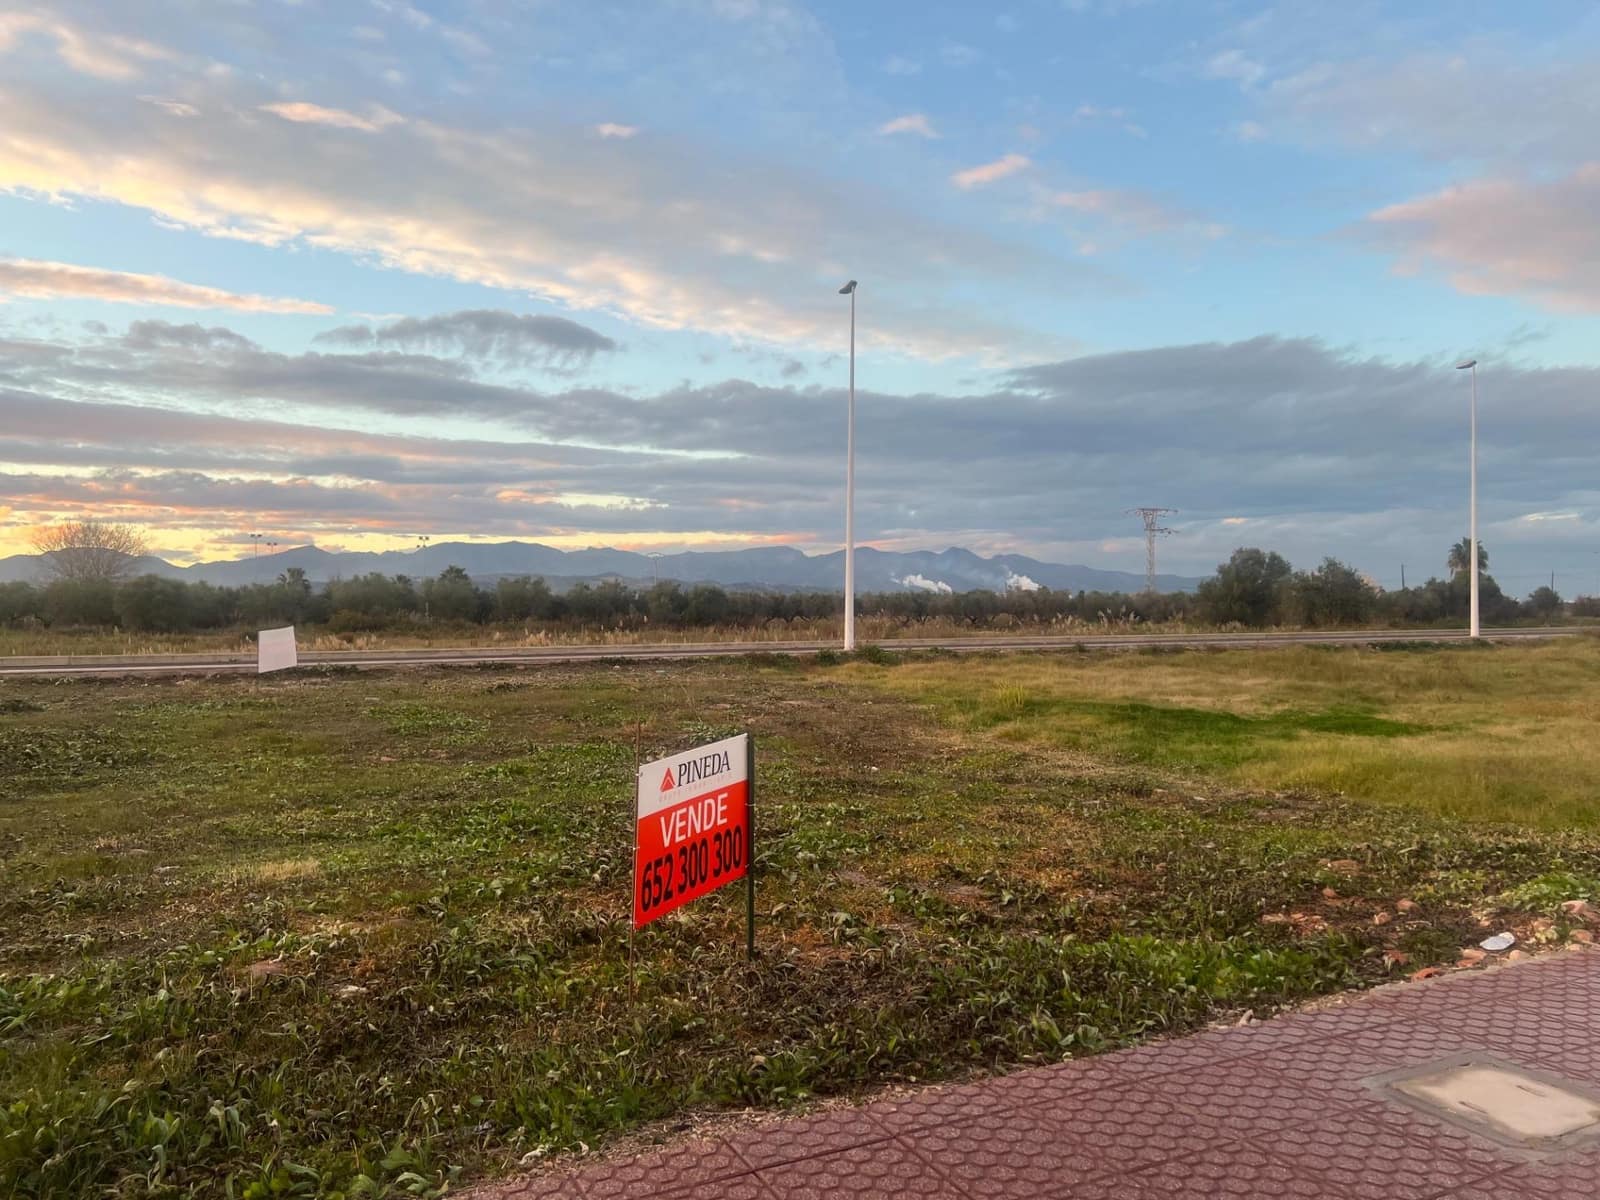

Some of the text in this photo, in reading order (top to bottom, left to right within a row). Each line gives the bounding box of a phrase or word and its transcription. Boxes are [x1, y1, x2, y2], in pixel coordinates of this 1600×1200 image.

[677, 751, 731, 788] PINEDA
[660, 793, 728, 848] VENDE
[641, 825, 743, 912] 652 300 300
